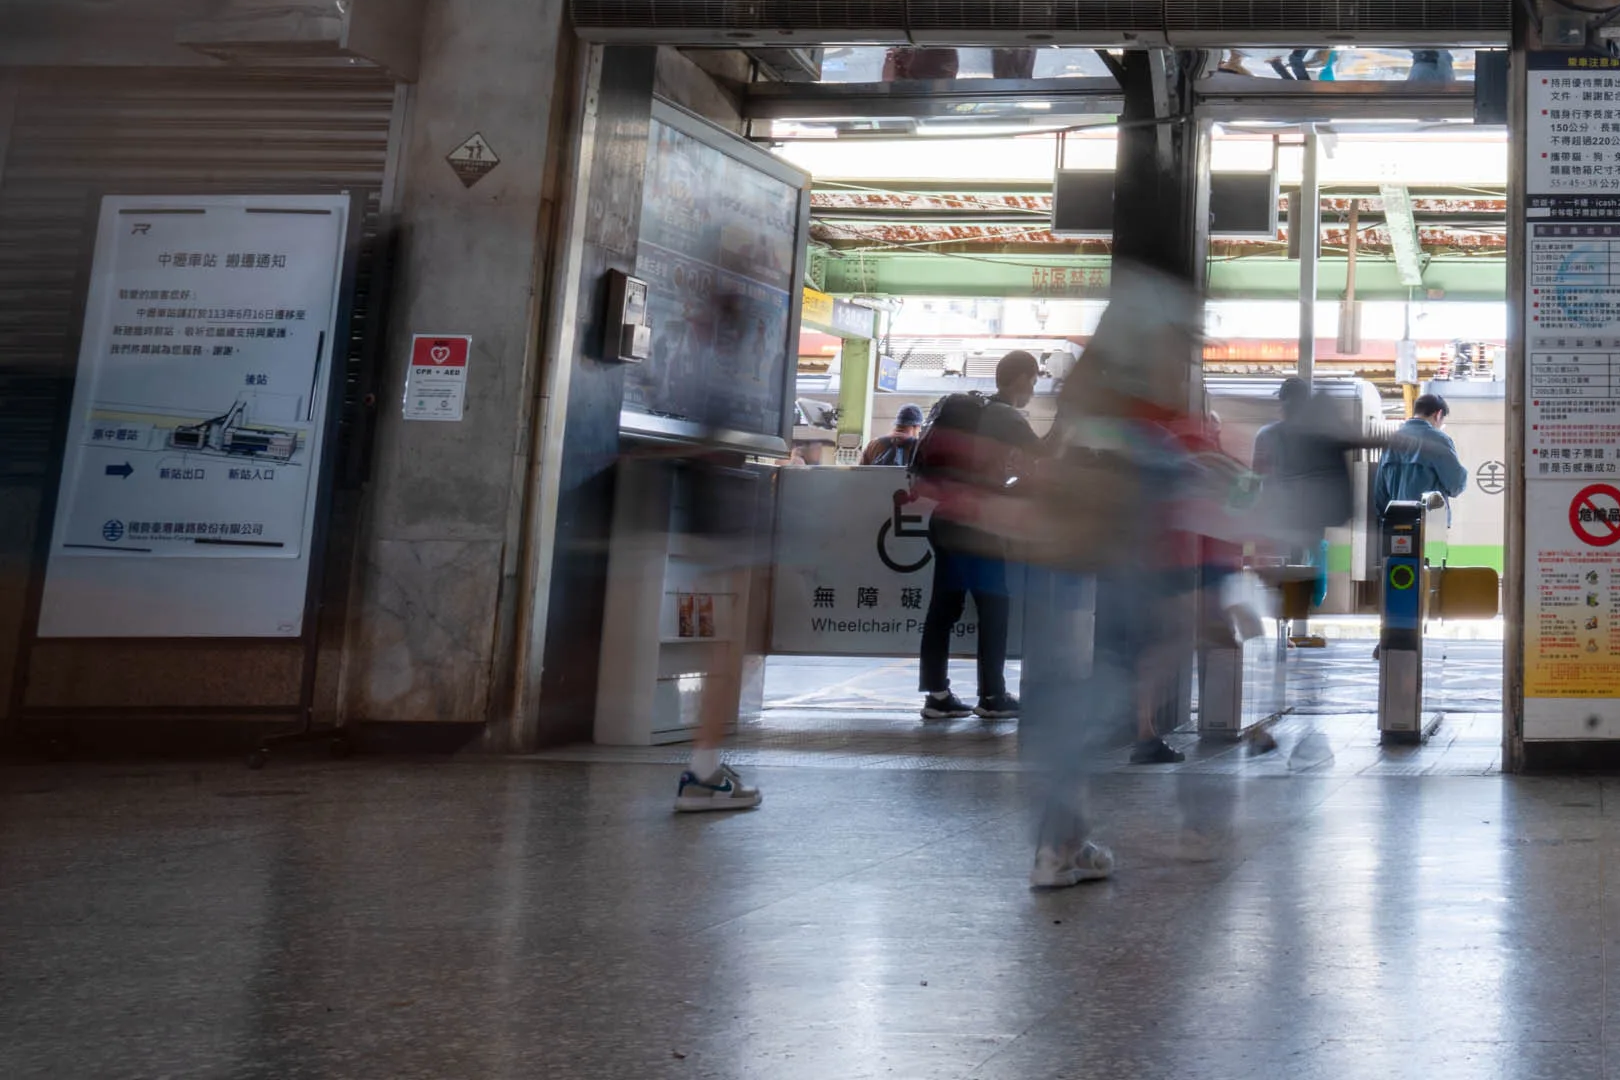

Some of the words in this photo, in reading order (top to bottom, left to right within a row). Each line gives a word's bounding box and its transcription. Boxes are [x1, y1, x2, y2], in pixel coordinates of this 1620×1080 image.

[158, 253, 217, 267] 中壢車站
[416, 368, 431, 376] CPR
[444, 368, 460, 376] AED
[812, 619, 901, 633] Wheelchair
